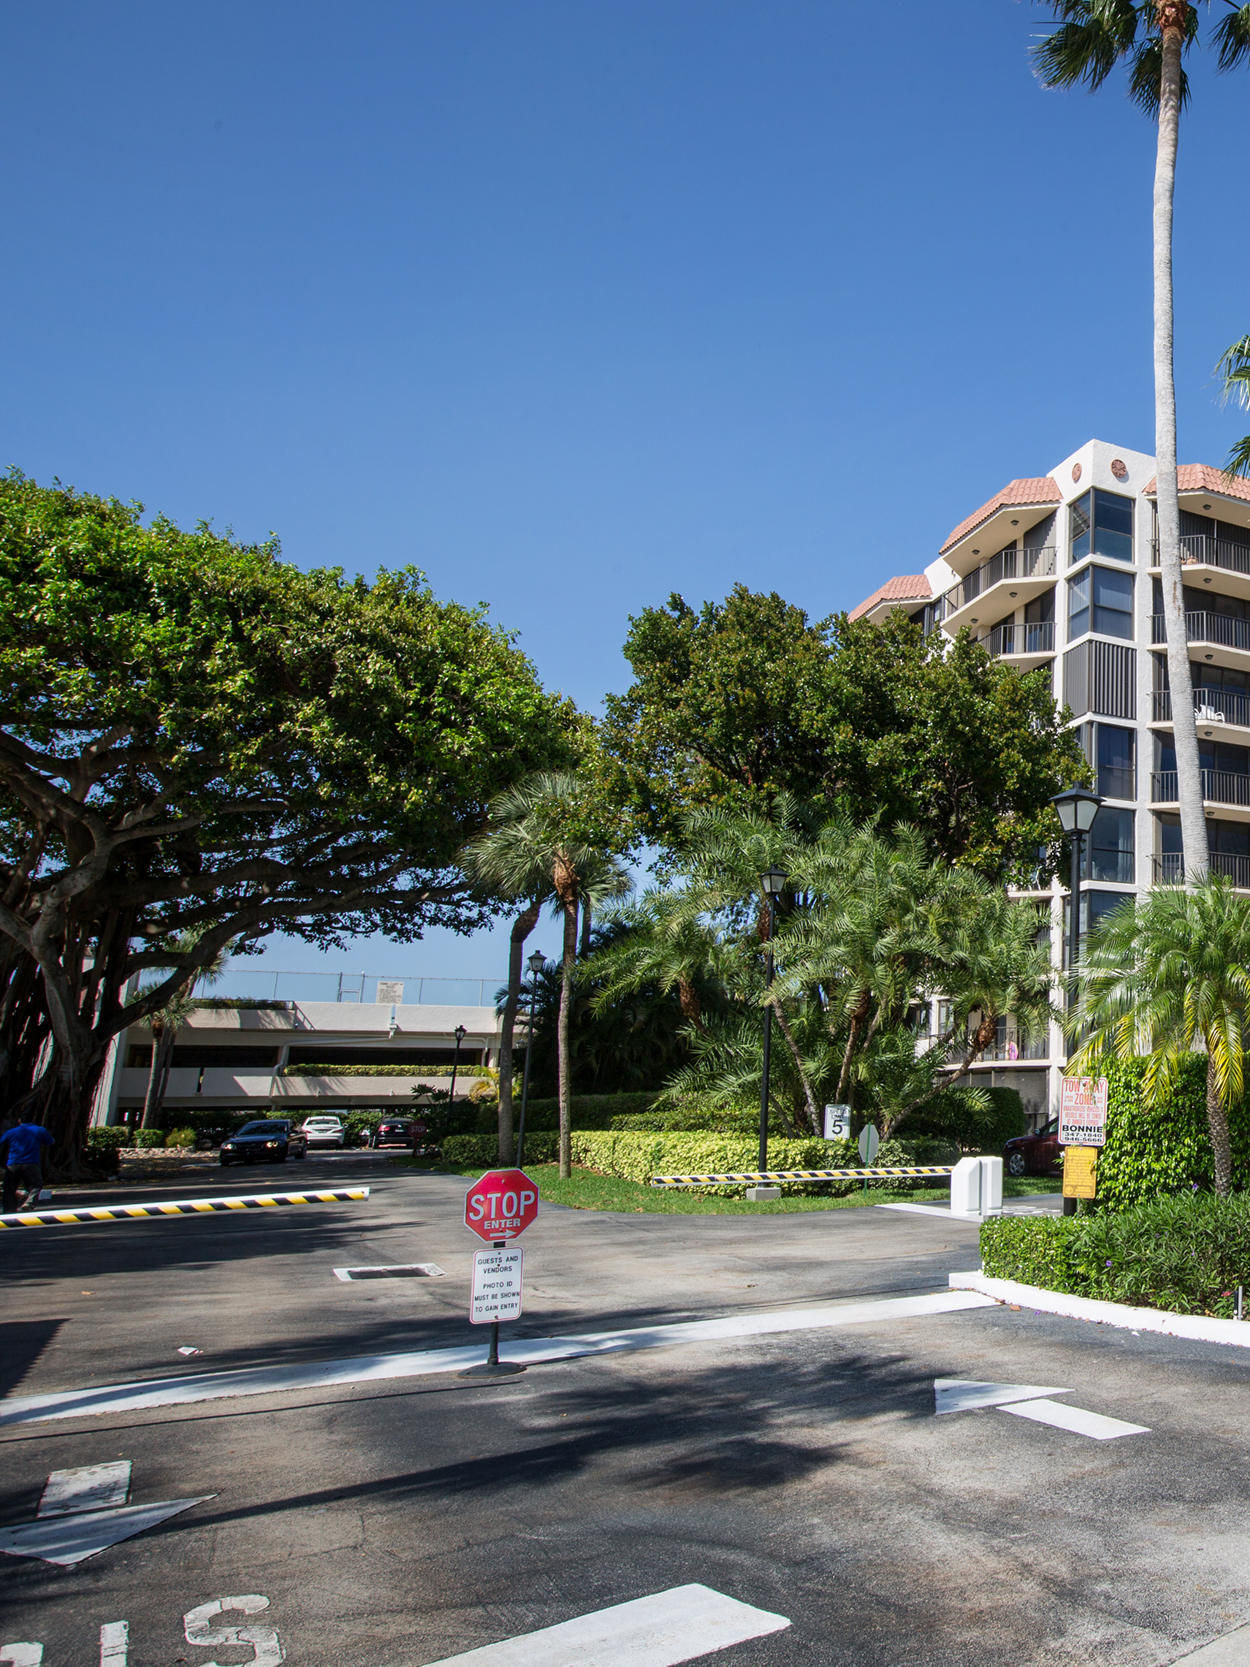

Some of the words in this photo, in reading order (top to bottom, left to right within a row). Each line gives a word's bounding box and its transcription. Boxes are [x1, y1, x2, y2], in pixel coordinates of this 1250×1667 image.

[1065, 1080, 1080, 1092] TOW
[1074, 1093, 1094, 1105] ZONE
[832, 1119, 843, 1135] 5
[1062, 1125, 1103, 1133] BONNIE
[469, 1190, 535, 1221] STOP
[484, 1217, 521, 1230] ENTER
[477, 1257, 503, 1265] GUESTS
[483, 1265, 513, 1274] VENDORS
[483, 1281, 505, 1289] PHOTO
[500, 1302, 518, 1310] ENTRY
